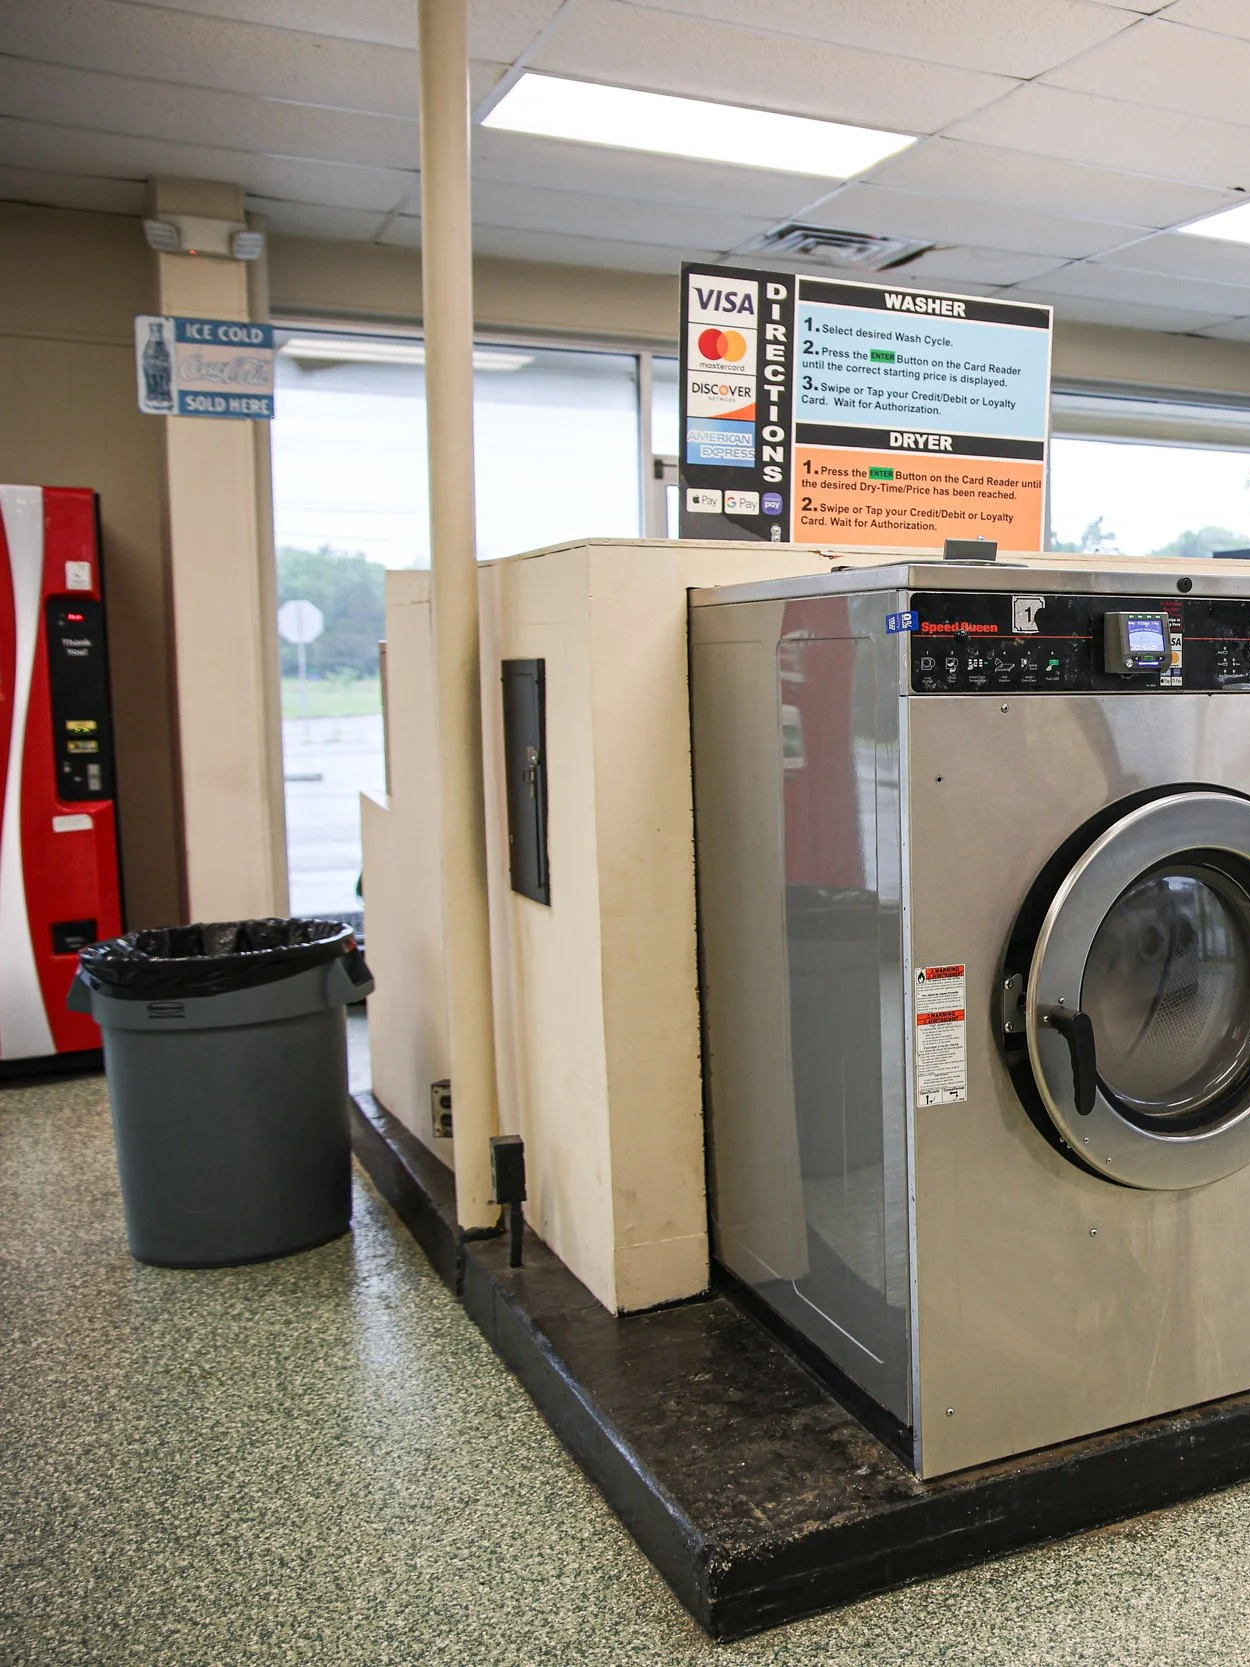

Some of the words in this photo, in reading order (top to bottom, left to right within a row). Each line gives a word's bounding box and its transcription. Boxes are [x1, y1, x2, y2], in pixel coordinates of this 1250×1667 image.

[692, 287, 754, 315] VISA
[884, 293, 966, 317] WASHER
[185, 323, 213, 340] ICE
[218, 326, 263, 343] COLD
[804, 317, 820, 332] 1.
[822, 324, 852, 336] Select
[856, 329, 892, 340] desired
[895, 332, 921, 343] Wash
[924, 336, 953, 347] Cycle.
[700, 362, 744, 371] mastercard
[803, 340, 819, 355] 2.
[822, 347, 849, 358] Press
[853, 351, 868, 360] the
[871, 352, 895, 360] ENTER
[897, 355, 928, 366] Button
[946, 360, 960, 369] the
[964, 362, 985, 372] Card
[989, 364, 1021, 375] Reader
[762, 282, 788, 483] DIRECTIONS
[802, 360, 824, 369] until
[828, 362, 842, 371] the
[846, 365, 880, 375] correct
[884, 369, 920, 380] starting
[923, 372, 946, 381] price
[950, 374, 957, 382] is
[960, 375, 1007, 387] displayed.
[692, 383, 751, 397] DISCOVER
[802, 376, 818, 391] 3.
[821, 383, 850, 394] Swipe
[867, 387, 884, 398] Tap
[887, 391, 909, 399] your
[911, 391, 967, 404] Credit/Debit
[970, 397, 980, 405] or
[982, 398, 1016, 410] Loyalty
[185, 396, 226, 412] SOLD
[229, 398, 271, 414] HERE
[802, 395, 828, 405] Card.
[834, 398, 855, 408] Wait
[858, 400, 871, 409] for
[874, 401, 941, 415] Authorization.
[688, 431, 750, 444] AMERICAN
[890, 432, 952, 451] DRYER
[702, 447, 755, 459] EXPRESS
[803, 460, 818, 474] 1.
[821, 466, 849, 476] Press
[852, 469, 867, 477] the
[870, 469, 893, 477] ENTER
[895, 471, 927, 482] Button
[945, 474, 959, 483] the
[962, 476, 984, 485] Card
[987, 477, 1019, 487] Reader
[1022, 480, 1041, 488] until
[802, 479, 817, 488] the
[820, 480, 856, 490] desired
[860, 482, 930, 495] Dry-Time/Price
[933, 487, 949, 496] has
[953, 488, 975, 497] been
[978, 490, 1016, 500] reached.
[702, 496, 717, 508] Pay
[739, 498, 757, 510] Pay
[765, 501, 780, 509] pay
[802, 497, 818, 512] 2.
[820, 503, 849, 514] Swipe
[866, 506, 882, 516] Tap
[886, 509, 907, 517] your
[910, 508, 965, 519] Credit/Debit
[980, 512, 1013, 523] Loyalty
[801, 516, 827, 525] Card.
[830, 517, 851, 526] Wait
[854, 519, 868, 528] for
[870, 519, 937, 531] Authorization.
[1024, 607, 1032, 623] 1
[921, 622, 958, 633] Speed
[960, 622, 998, 633] Queen
